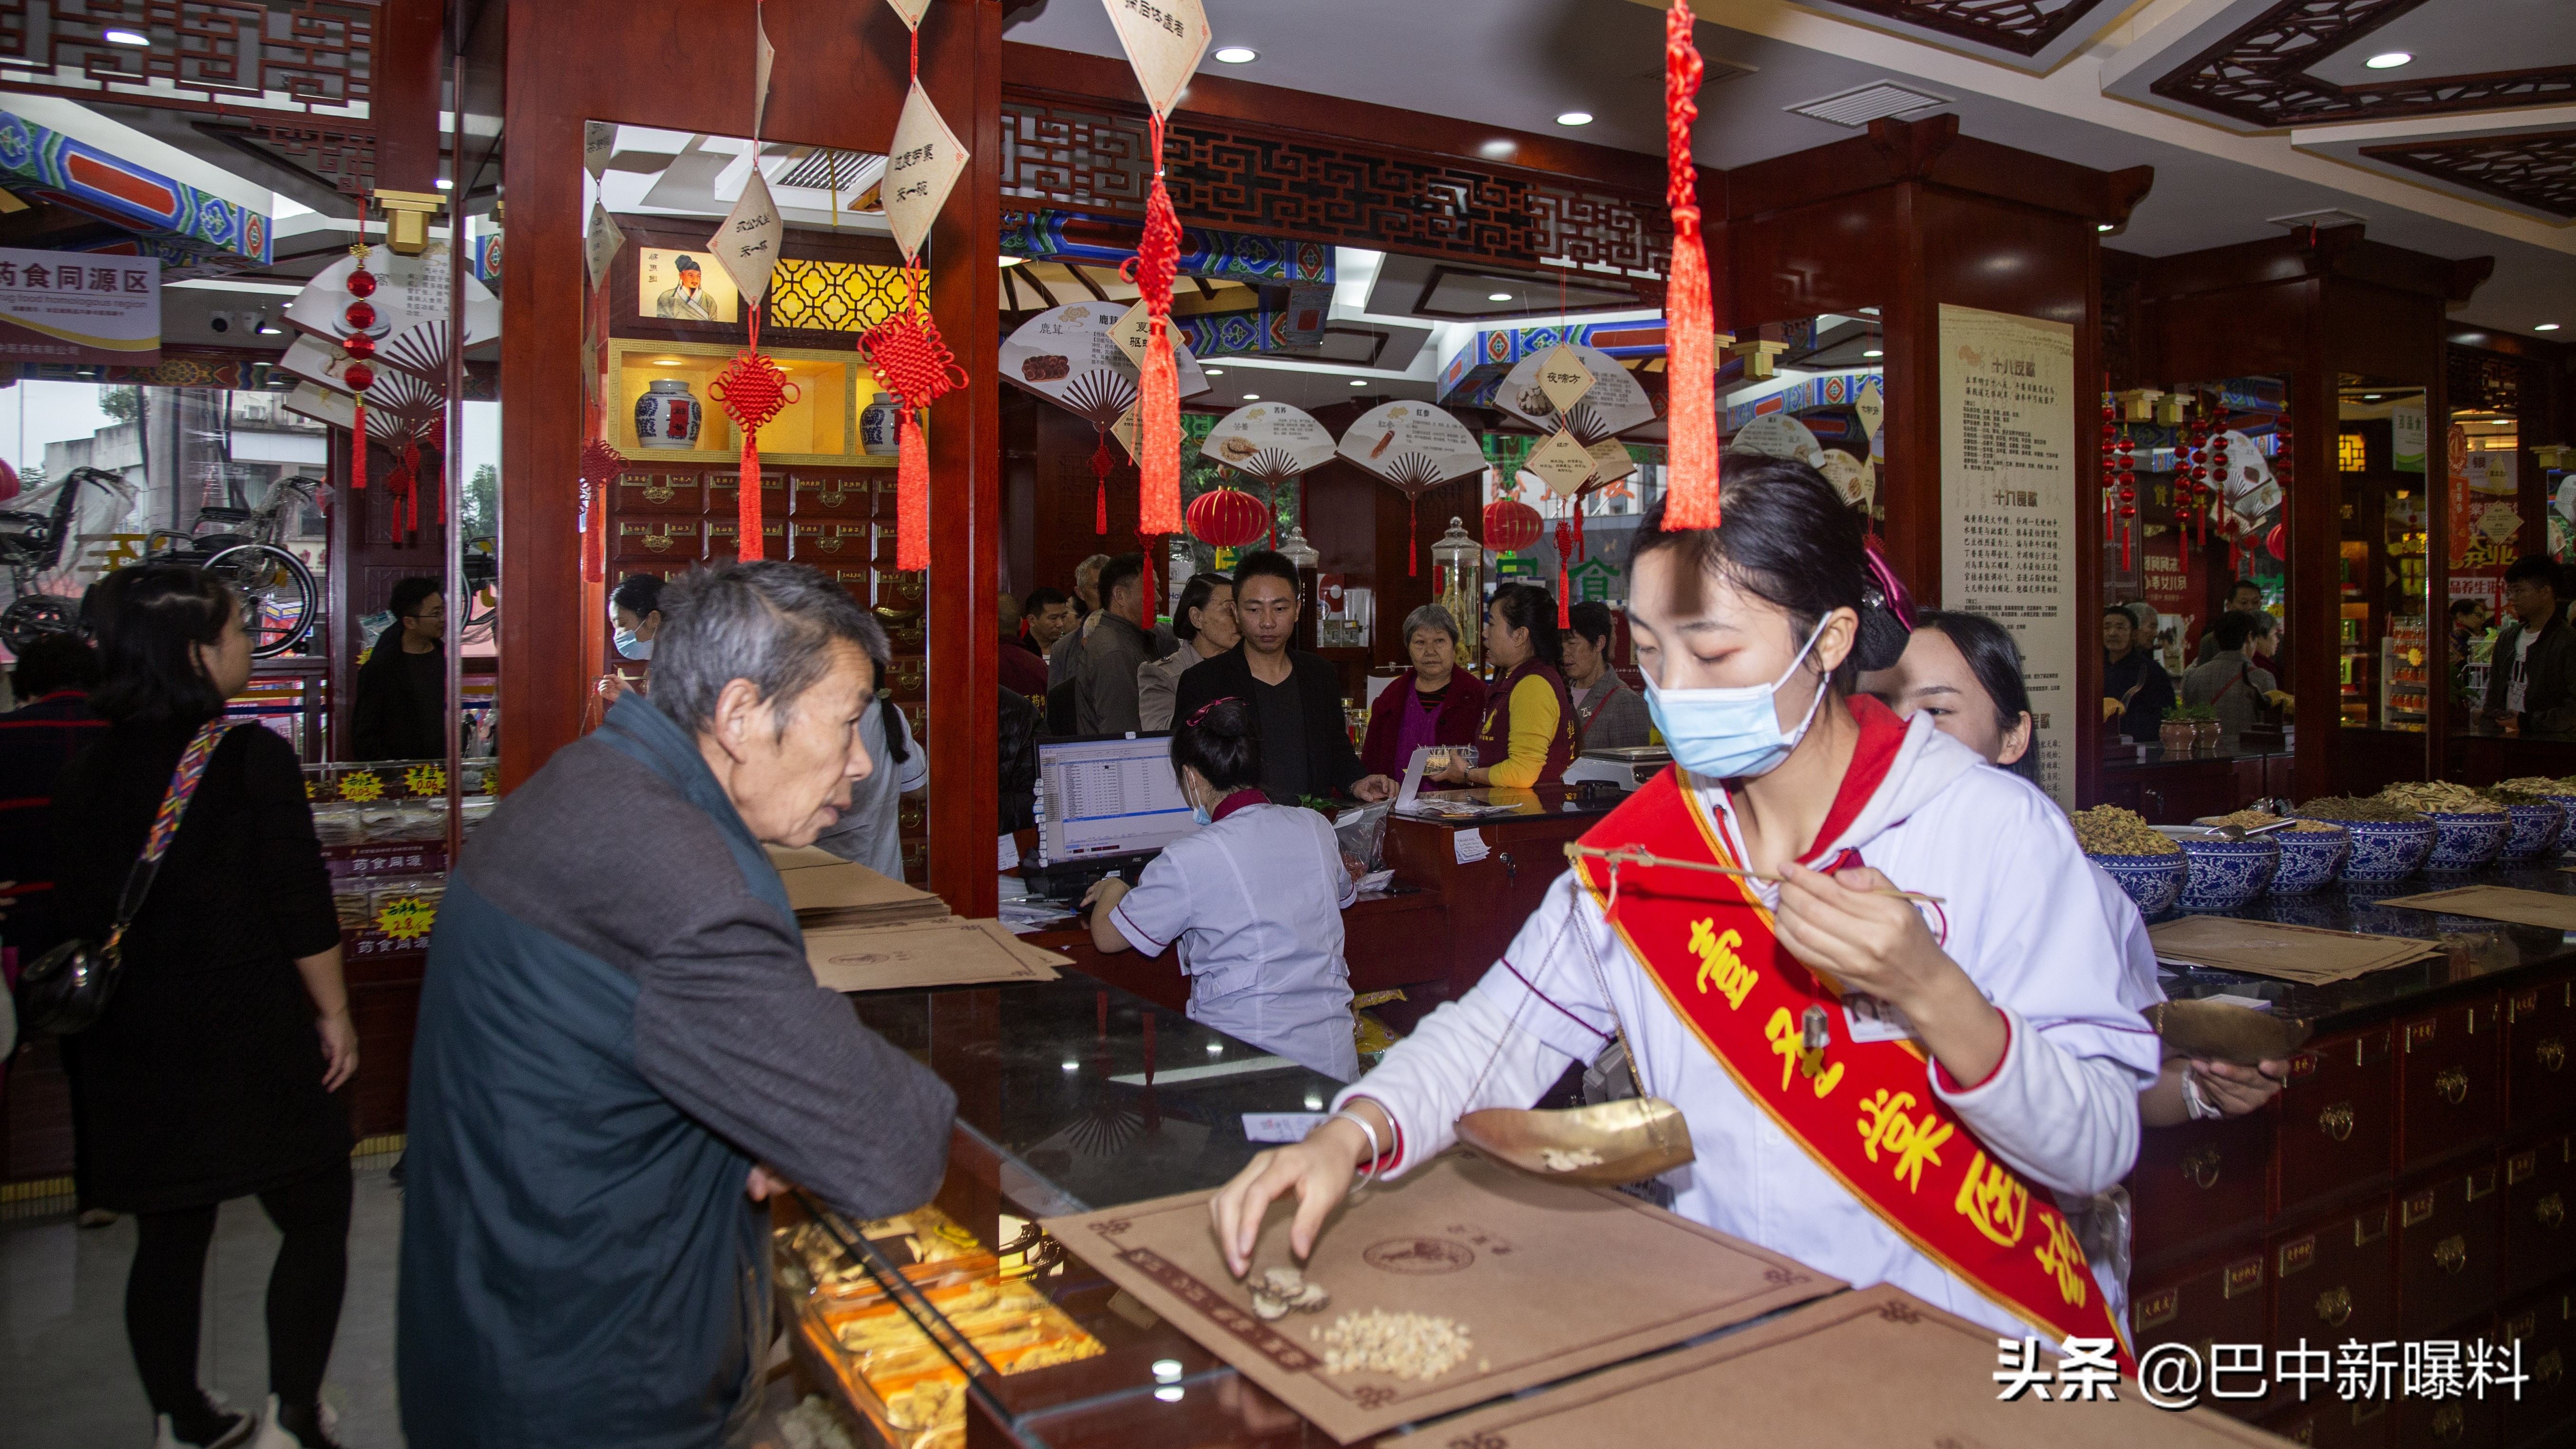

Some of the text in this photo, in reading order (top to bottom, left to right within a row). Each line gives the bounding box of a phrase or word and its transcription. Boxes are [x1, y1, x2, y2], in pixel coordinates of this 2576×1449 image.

[1099, 314, 1119, 325] 鹿茸
[1039, 323, 1063, 335] 鹿茸
[1992, 358, 2036, 377] 十八反歌
[1547, 372, 1580, 384] 夜啼方
[1994, 489, 2038, 507] 十九畏歌
[412, 768, 437, 780] 黑豆
[353, 854, 423, 871] 药食同源
